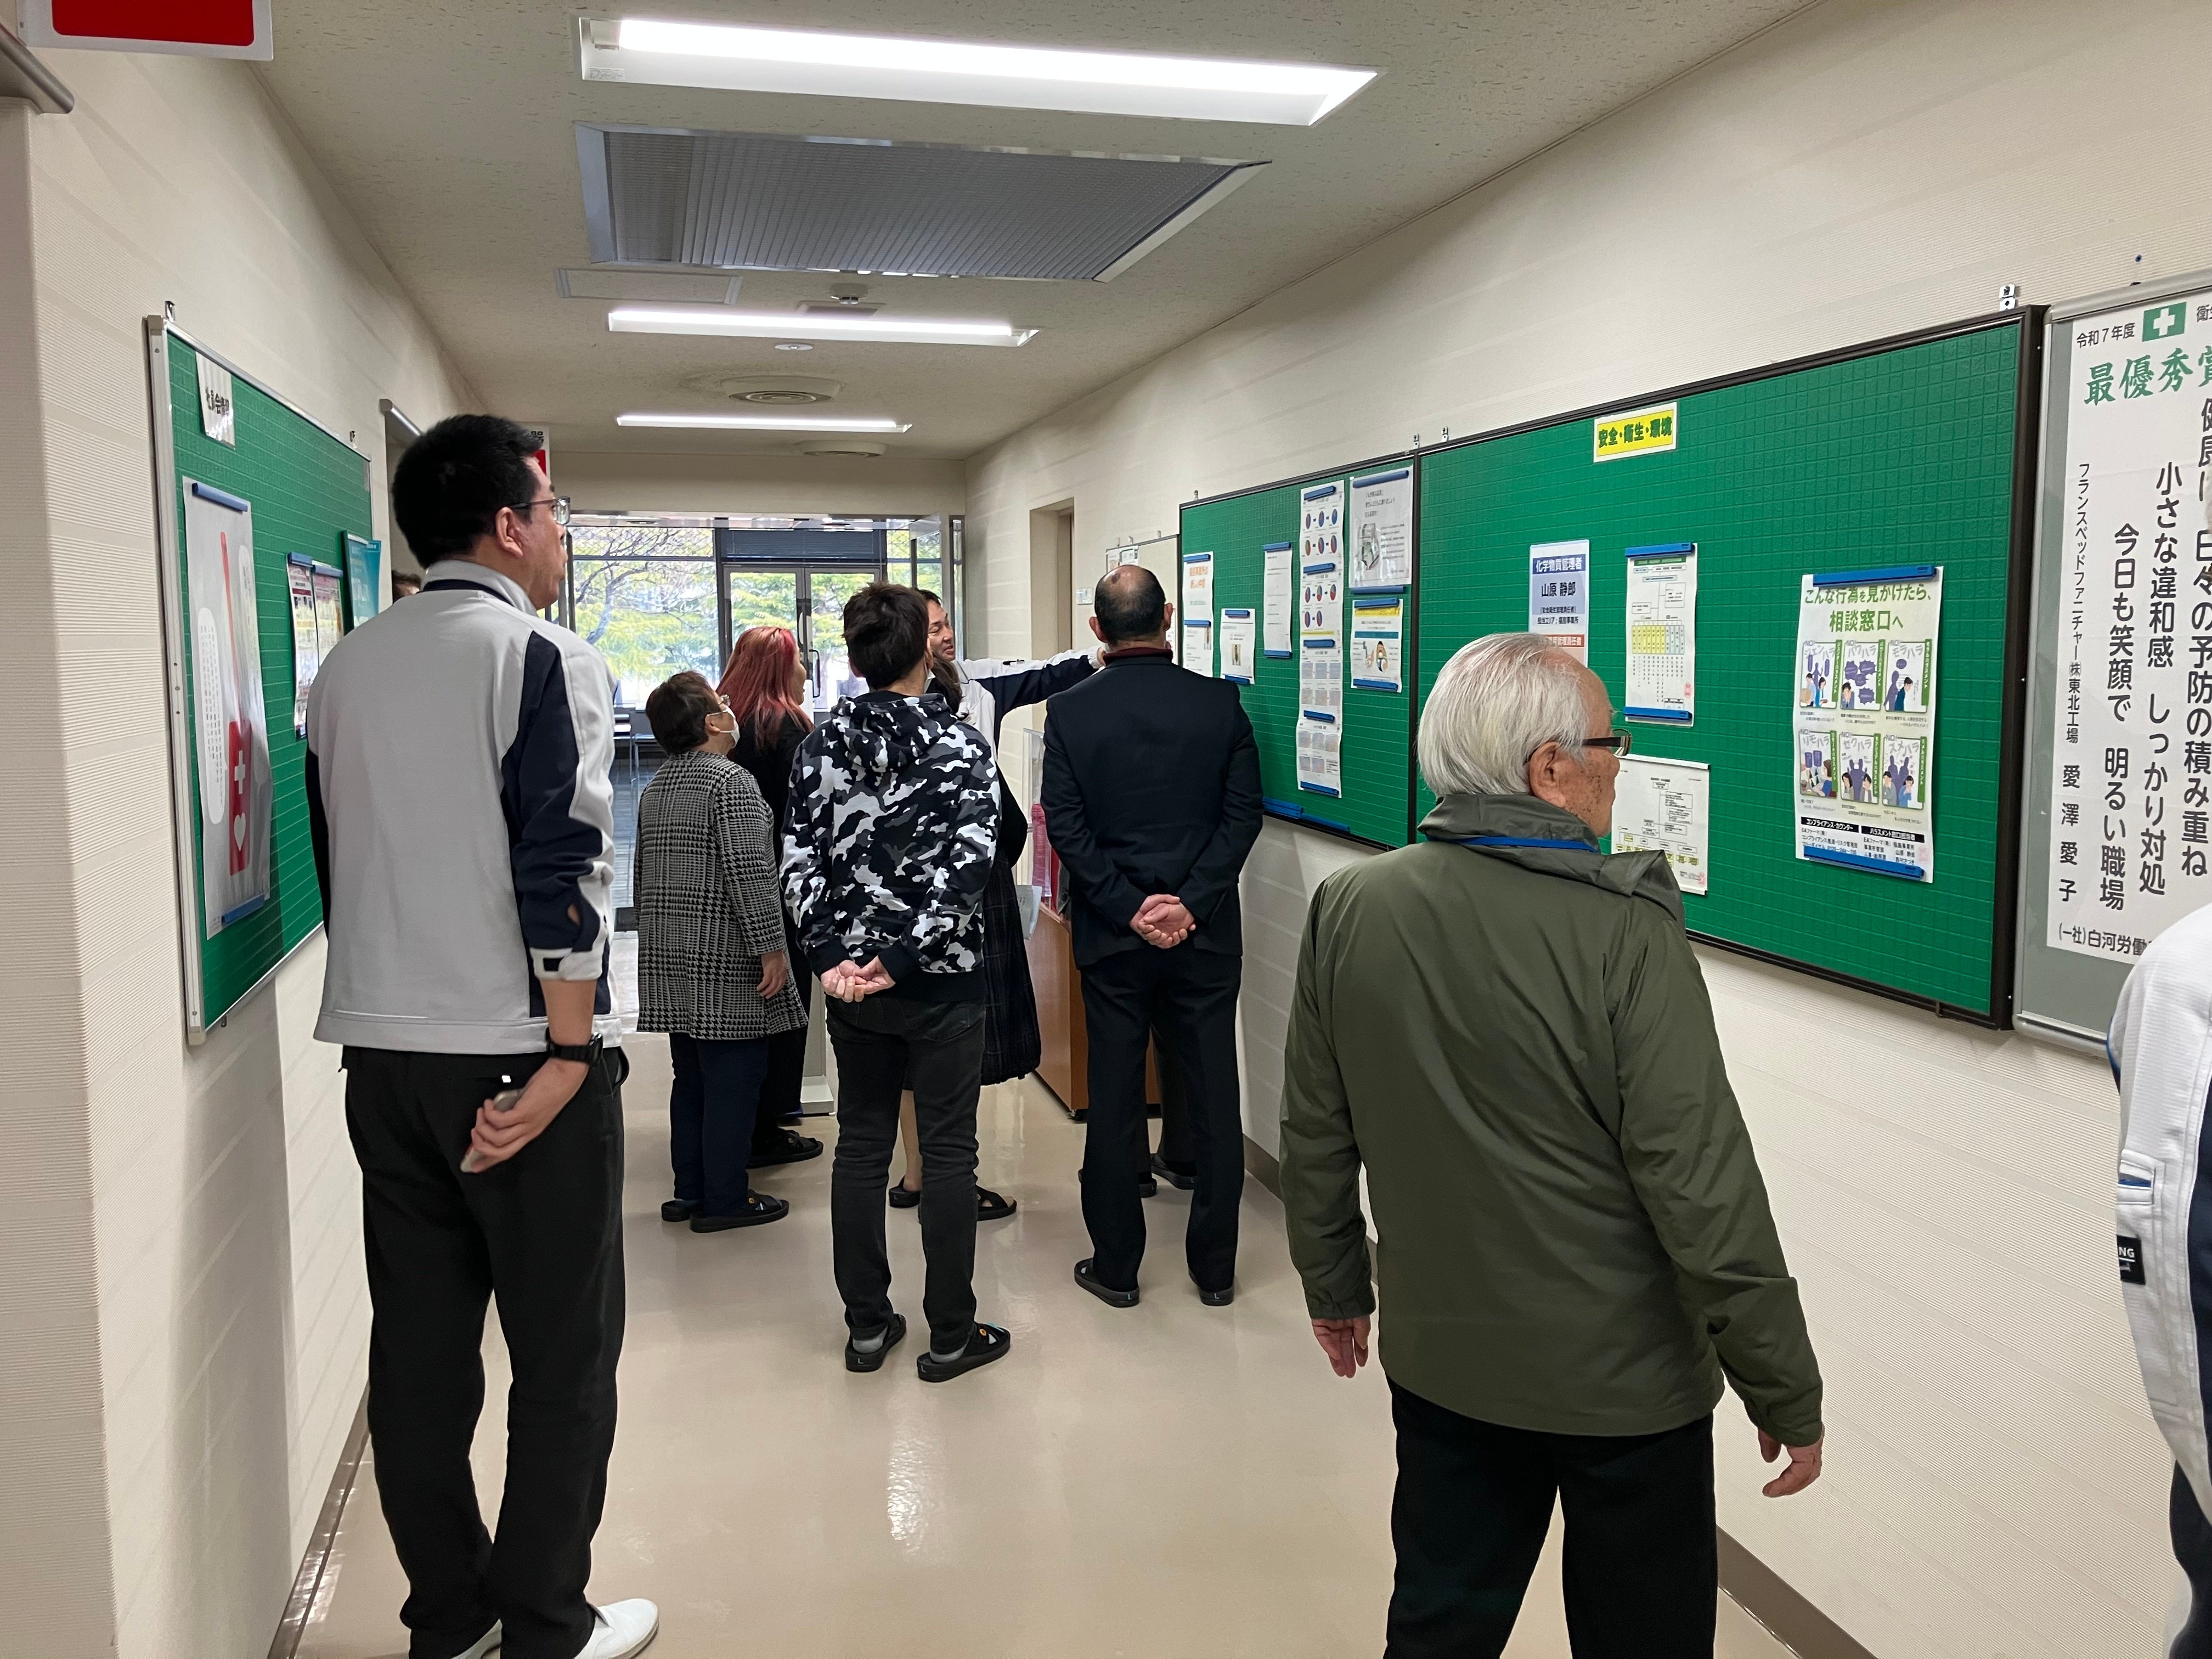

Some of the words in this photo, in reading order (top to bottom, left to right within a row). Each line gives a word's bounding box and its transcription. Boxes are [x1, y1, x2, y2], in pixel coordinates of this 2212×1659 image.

[2148, 461, 2182, 668] 小さな違和感
[1805, 584, 1931, 604] こんな行為を見かけたら、
[1829, 609, 1904, 633] 相談窓口へ
[2108, 523, 2139, 723] 今日も笑顔で
[1893, 645, 1923, 659] モラハラ
[1843, 737, 1872, 752] セクハラ
[2140, 693, 2170, 895] しっかり対処
[2100, 747, 2129, 911] 明るい職場
[2058, 922, 2152, 956] (一社)白河労働
[921, 1364, 927, 1373] L
